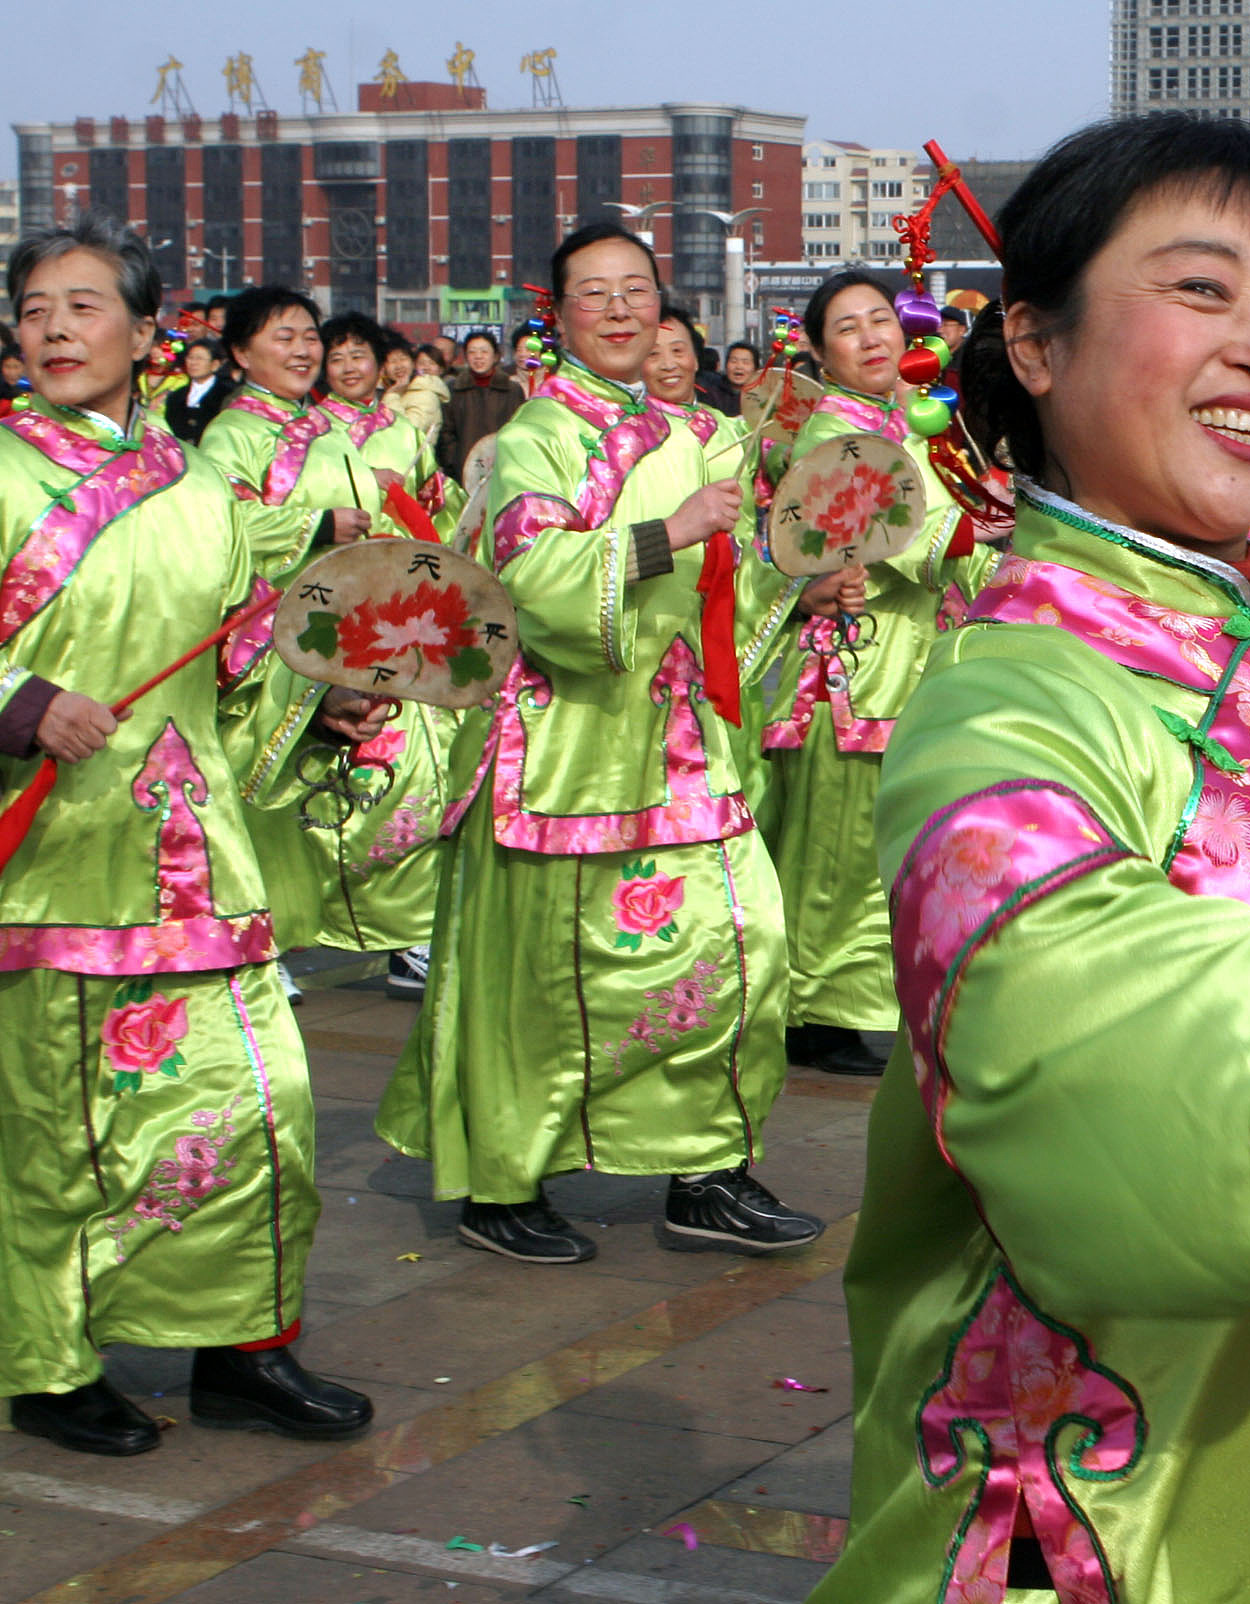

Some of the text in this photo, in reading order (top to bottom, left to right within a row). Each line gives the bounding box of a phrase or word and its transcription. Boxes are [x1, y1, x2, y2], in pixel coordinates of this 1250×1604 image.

[149, 41, 557, 105] 广博商务中心
[840, 440, 860, 461] 天
[780, 504, 801, 524] 太
[407, 553, 441, 581] 天
[298, 582, 334, 606] 太
[367, 666, 398, 686] 下
